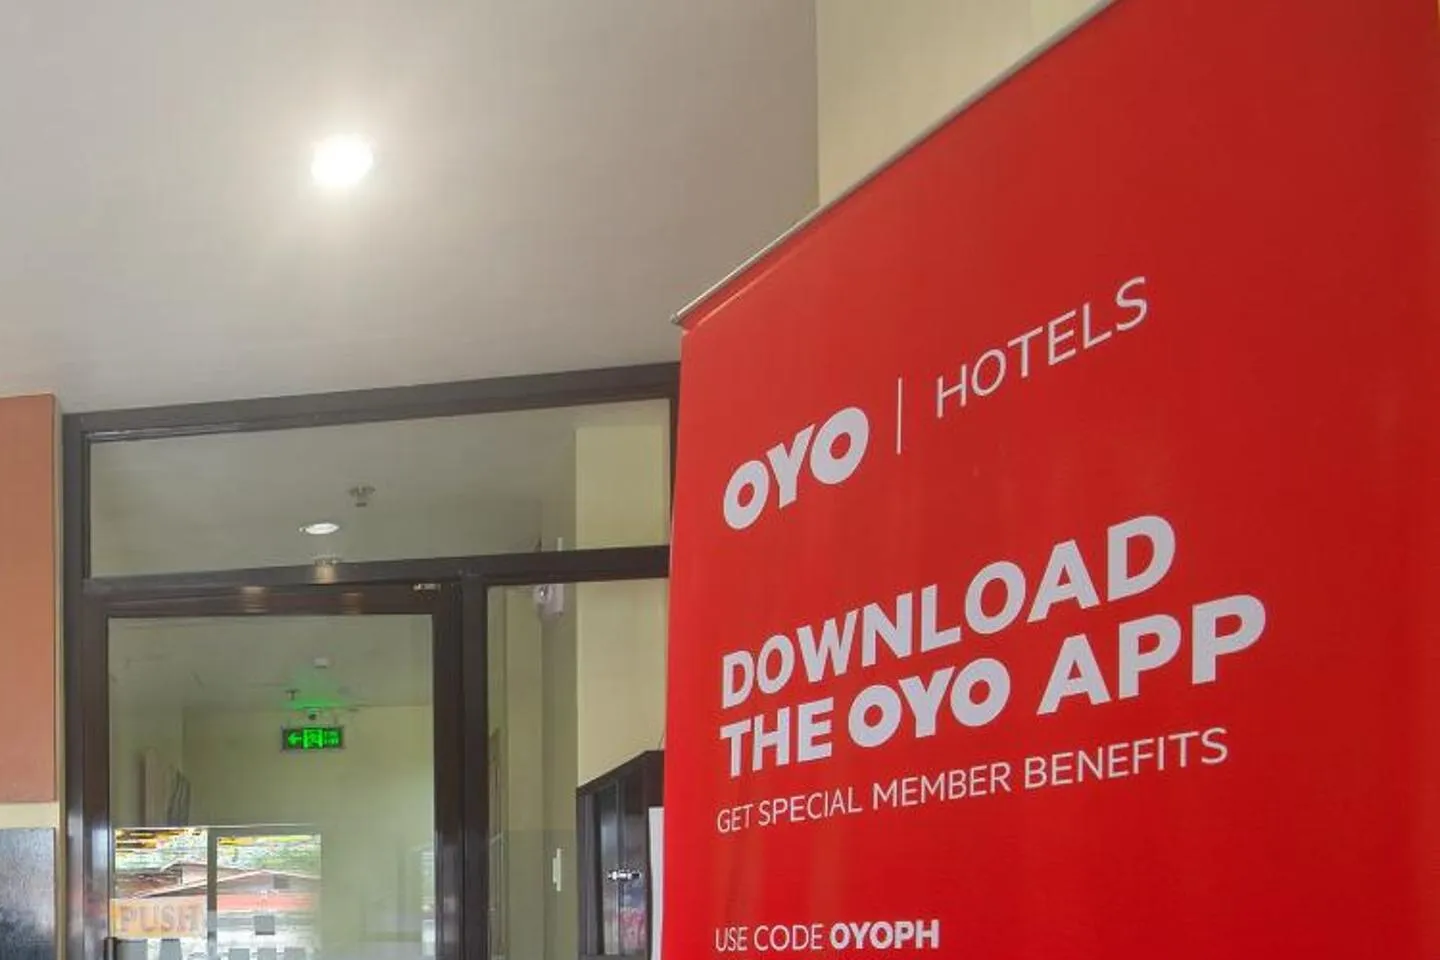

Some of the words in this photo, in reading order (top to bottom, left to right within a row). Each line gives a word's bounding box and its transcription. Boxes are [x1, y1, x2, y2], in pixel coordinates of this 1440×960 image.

[723, 407, 869, 530] OYO
[936, 276, 1148, 419] HOTELS
[721, 515, 1176, 709] DOWNLOAD
[719, 696, 835, 778] THE
[848, 658, 1011, 748] OYO
[1036, 594, 1266, 716] APP
[717, 803, 754, 834] GET
[758, 786, 863, 826] SPECIAL
[872, 761, 1011, 810] MEMBER
[1024, 727, 1228, 789] BENEFITS
[119, 904, 201, 933] PUSH
[715, 926, 748, 951] USE
[754, 924, 824, 951] CODE
[829, 919, 939, 950] OYOPH
